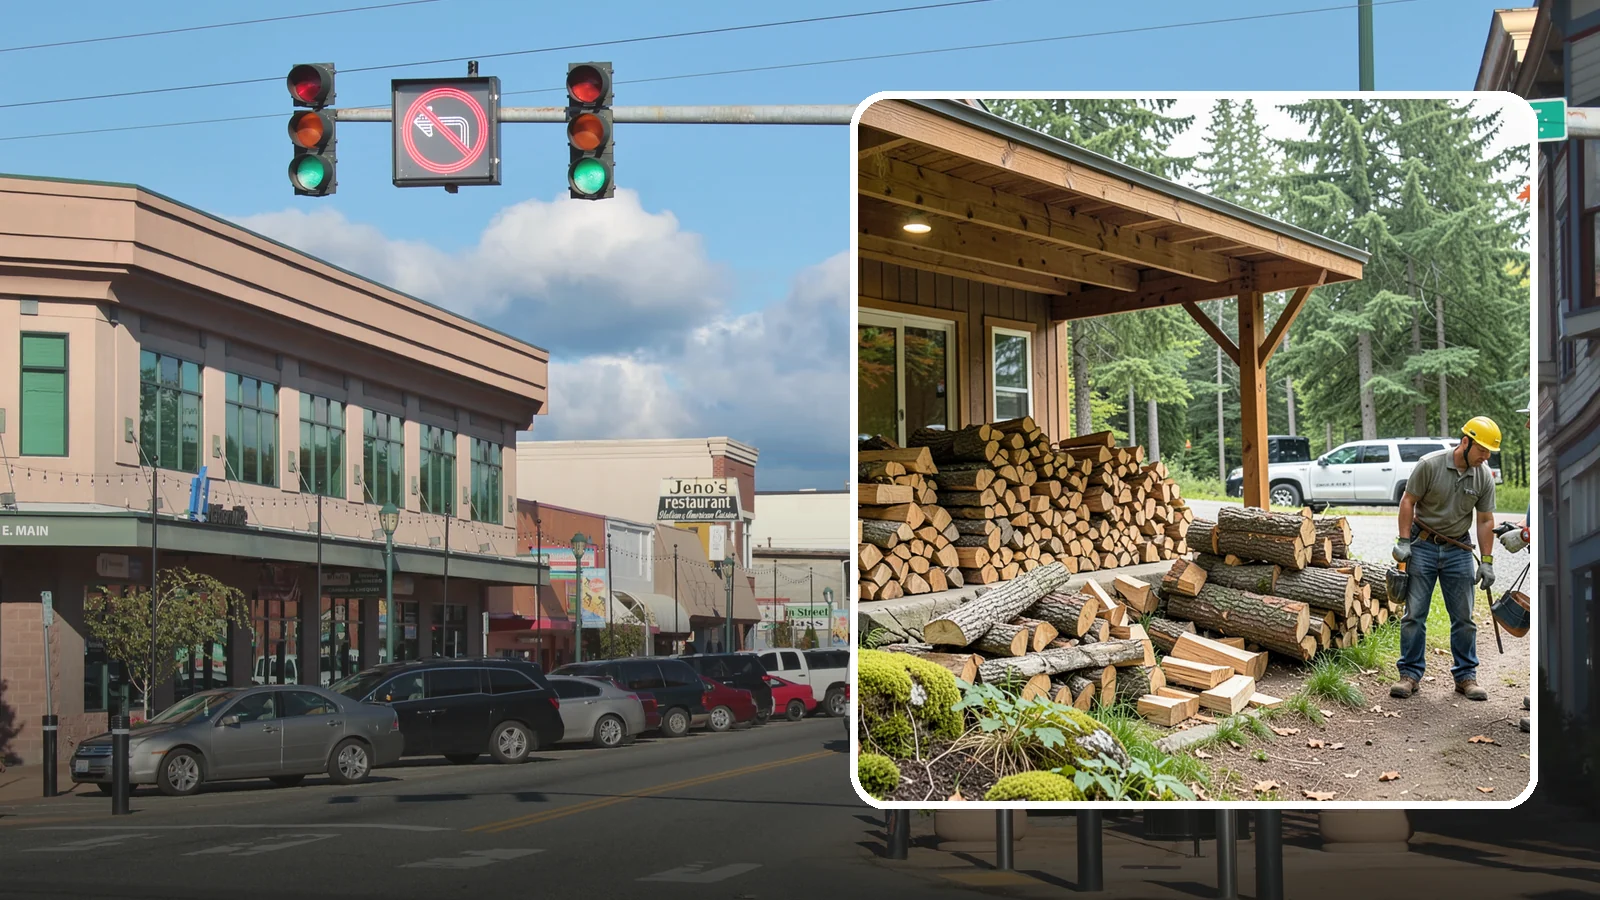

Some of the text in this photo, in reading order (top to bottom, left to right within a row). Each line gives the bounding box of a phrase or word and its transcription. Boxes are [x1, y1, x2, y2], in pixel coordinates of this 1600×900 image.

[669, 480, 727, 494] Jeno's
[665, 496, 731, 509] restaurant
[658, 510, 681, 520] Italian
[686, 509, 714, 520] American
[715, 509, 737, 520] Cuisine
[2, 525, 49, 536] E. MAIN
[797, 608, 828, 616] Street
